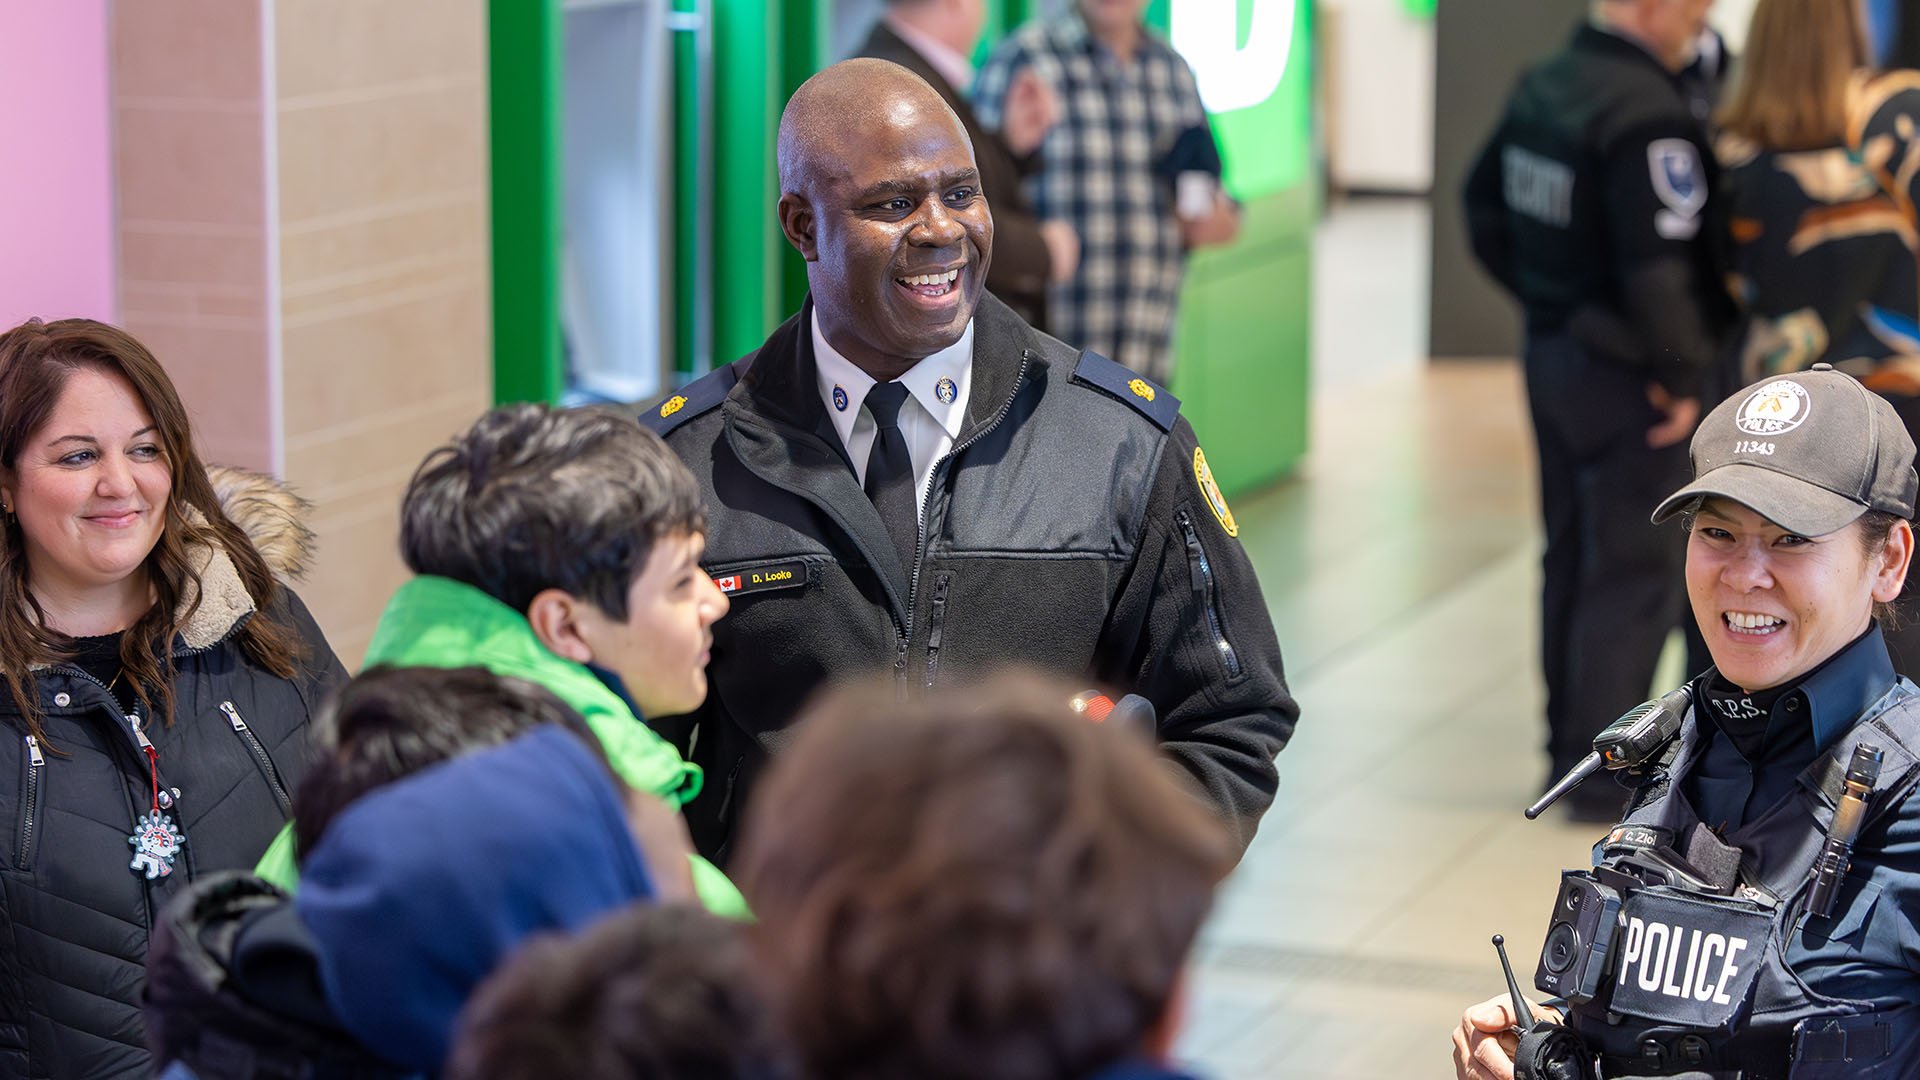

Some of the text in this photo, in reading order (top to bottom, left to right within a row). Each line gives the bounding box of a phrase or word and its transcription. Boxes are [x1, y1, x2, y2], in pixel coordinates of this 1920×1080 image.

[1743, 418, 1785, 432] POLICE
[1733, 440, 1776, 456] 11343
[752, 574, 763, 584] D.
[1619, 916, 1748, 1005] POLICE
